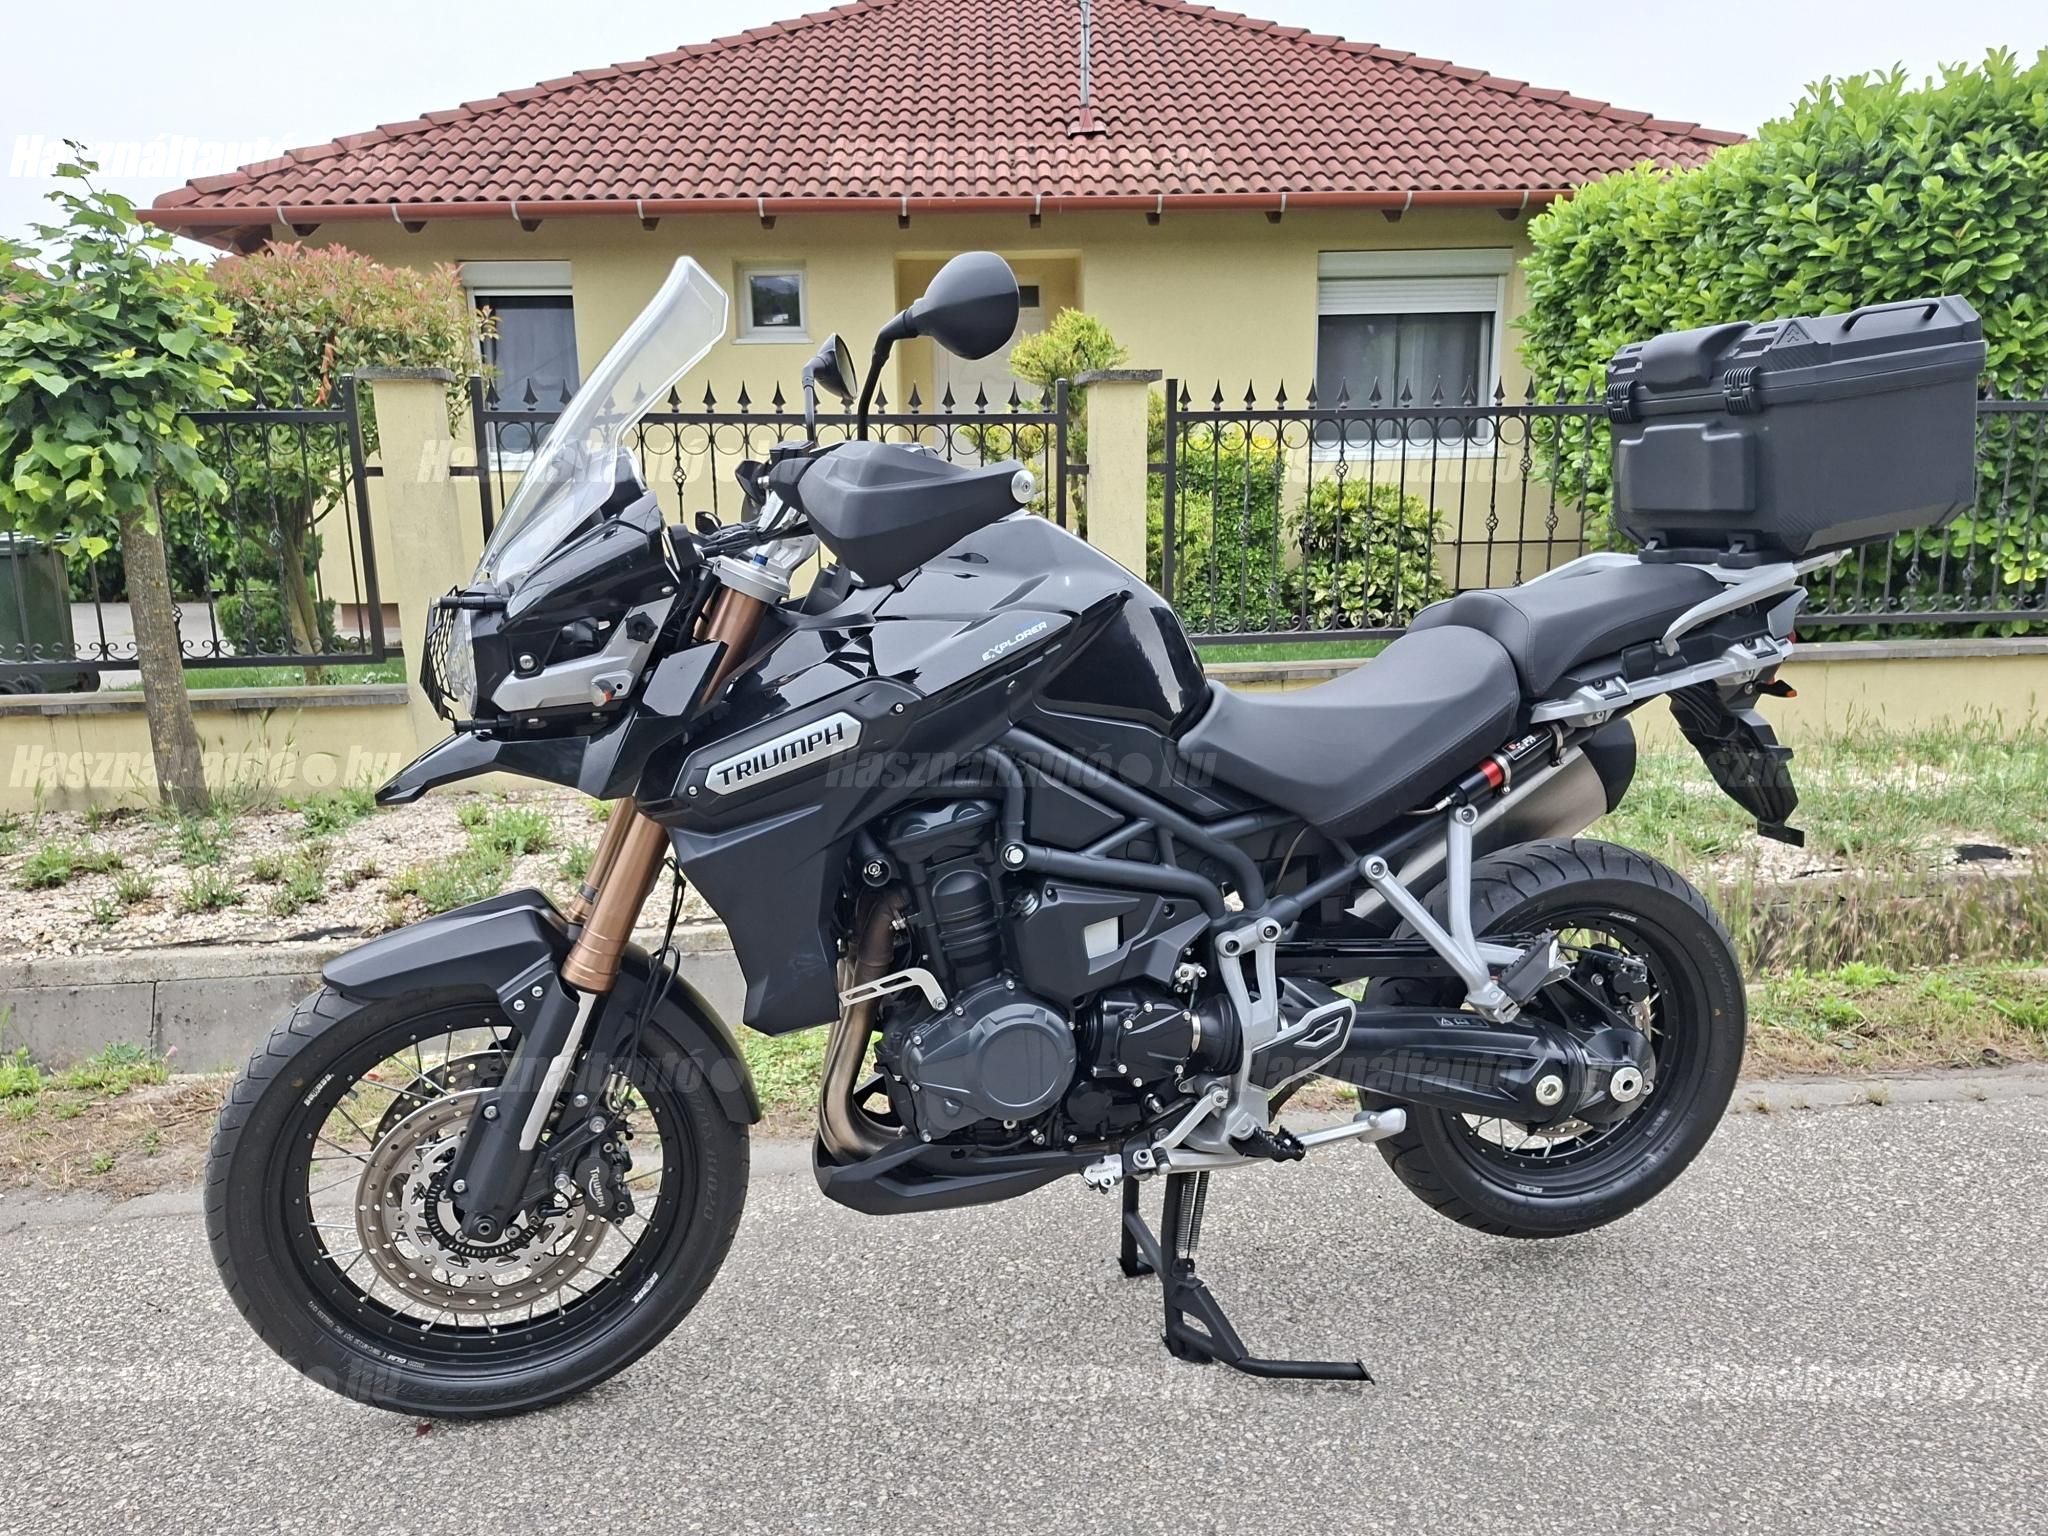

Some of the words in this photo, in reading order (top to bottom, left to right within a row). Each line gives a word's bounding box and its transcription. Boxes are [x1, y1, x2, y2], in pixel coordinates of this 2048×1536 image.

[981, 621, 1048, 661] EXPLORER
[716, 722, 844, 786] TRIUMPH
[589, 1166, 606, 1208] TRIUMPH
